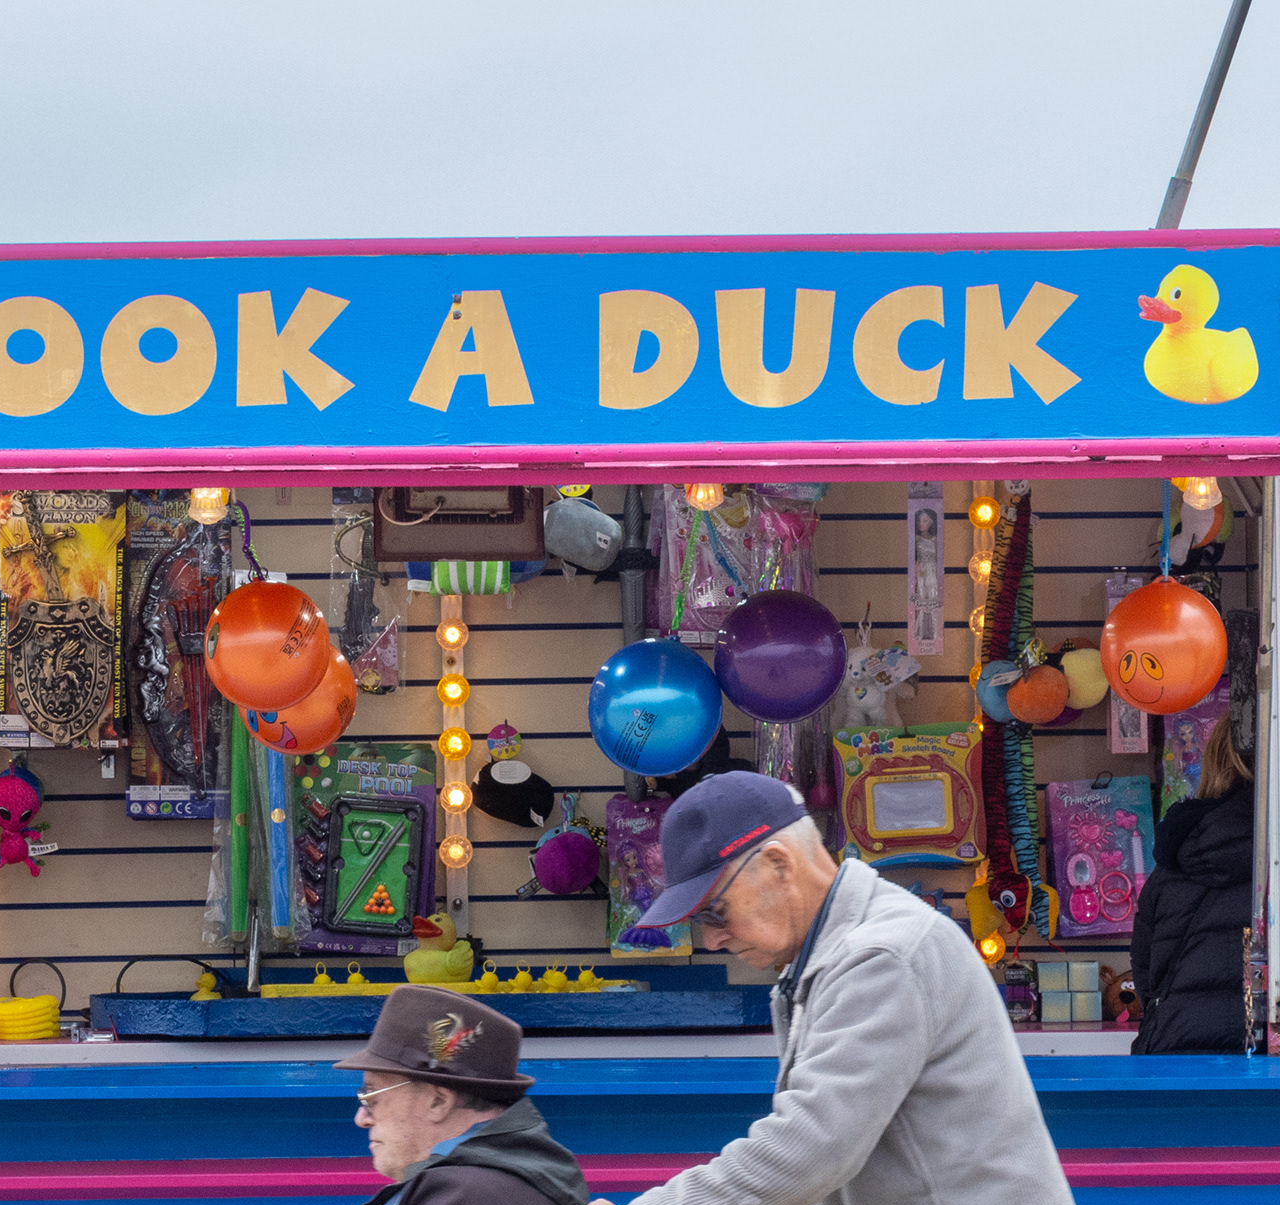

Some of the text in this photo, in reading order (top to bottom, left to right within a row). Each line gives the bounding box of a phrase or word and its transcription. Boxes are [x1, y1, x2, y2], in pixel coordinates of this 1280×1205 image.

[408, 290, 535, 412] A
[598, 281, 1082, 410] DUCK
[916, 736, 941, 745] Magic
[902, 745, 956, 757] Sketch Board
[337, 760, 418, 779] DESK TOP
[359, 776, 418, 798] POOL
[1063, 793, 1101, 808] Princess
